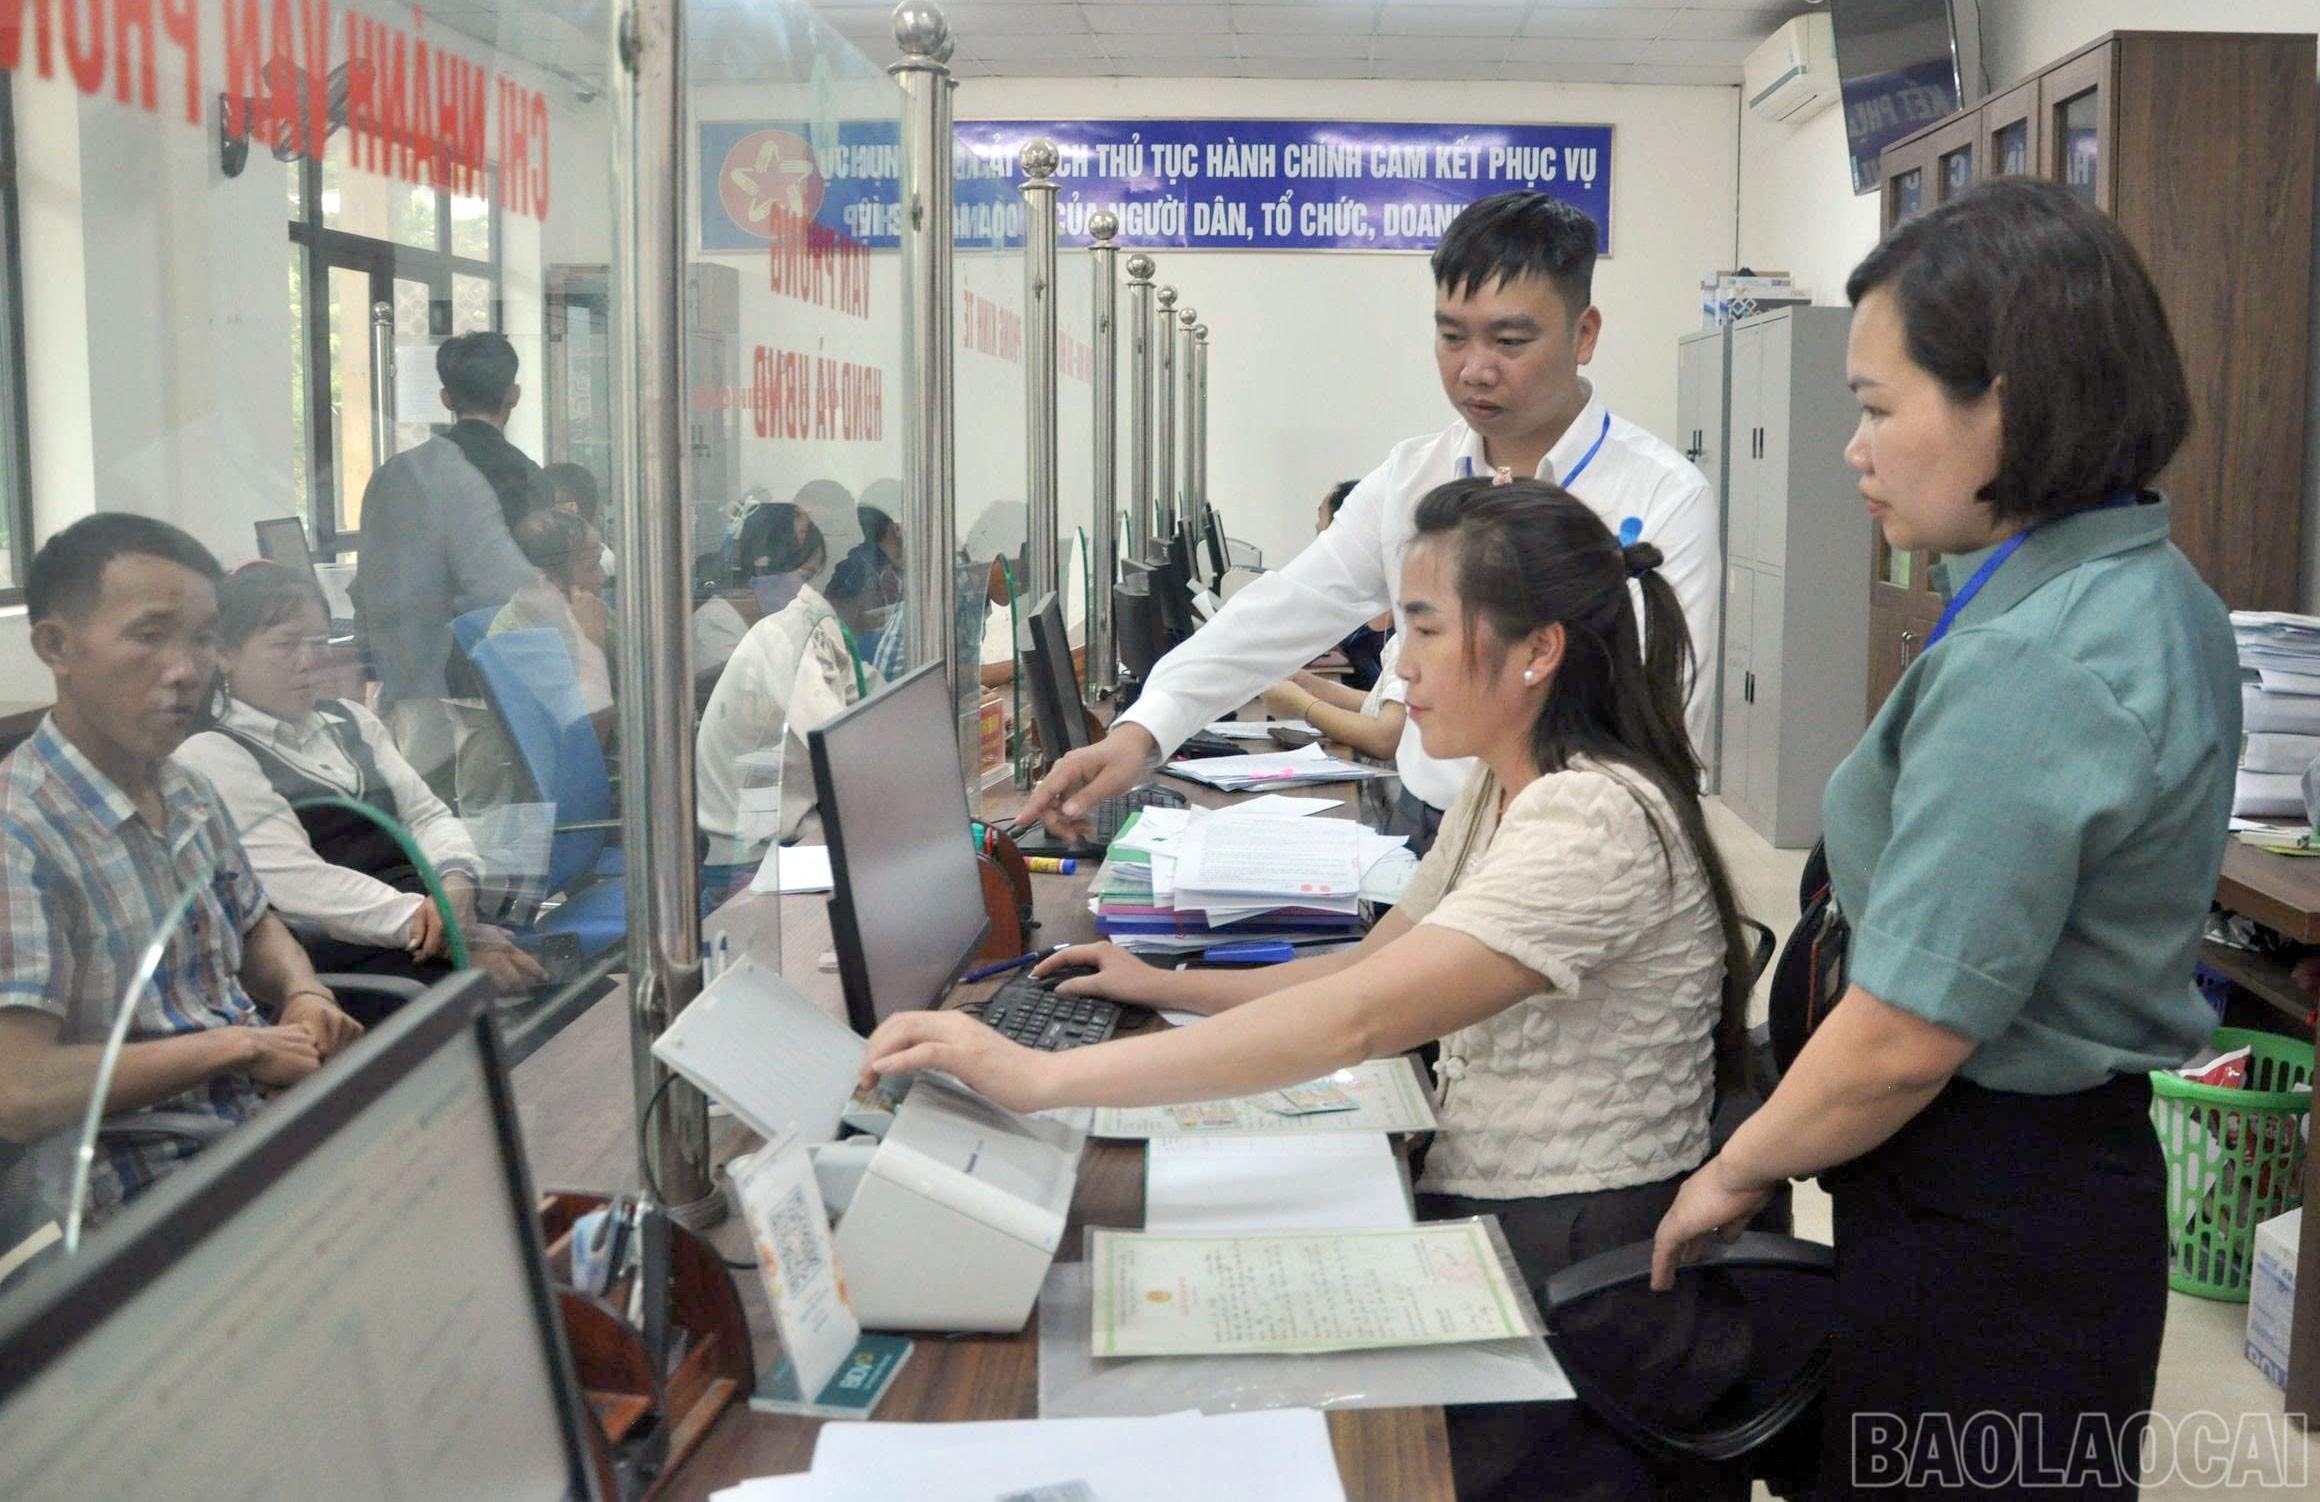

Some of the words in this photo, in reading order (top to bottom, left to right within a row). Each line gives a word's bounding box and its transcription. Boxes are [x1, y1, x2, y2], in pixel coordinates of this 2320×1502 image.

[1096, 133, 1143, 178] THỦ
[1151, 145, 1198, 185] TỤC
[1206, 137, 1275, 178] HÀNH
[1283, 138, 1362, 178] CHÍNH
[1370, 144, 1427, 179] CAM
[1435, 135, 1482, 179] KẾT
[1488, 145, 1557, 188] PHỤC
[1564, 147, 1597, 190] VỤ
[1193, 196, 1254, 240] DÂN,
[1261, 189, 1294, 236] TỔ
[1300, 196, 1376, 240] CHỨC,
[1383, 203, 1468, 237] DOAN
